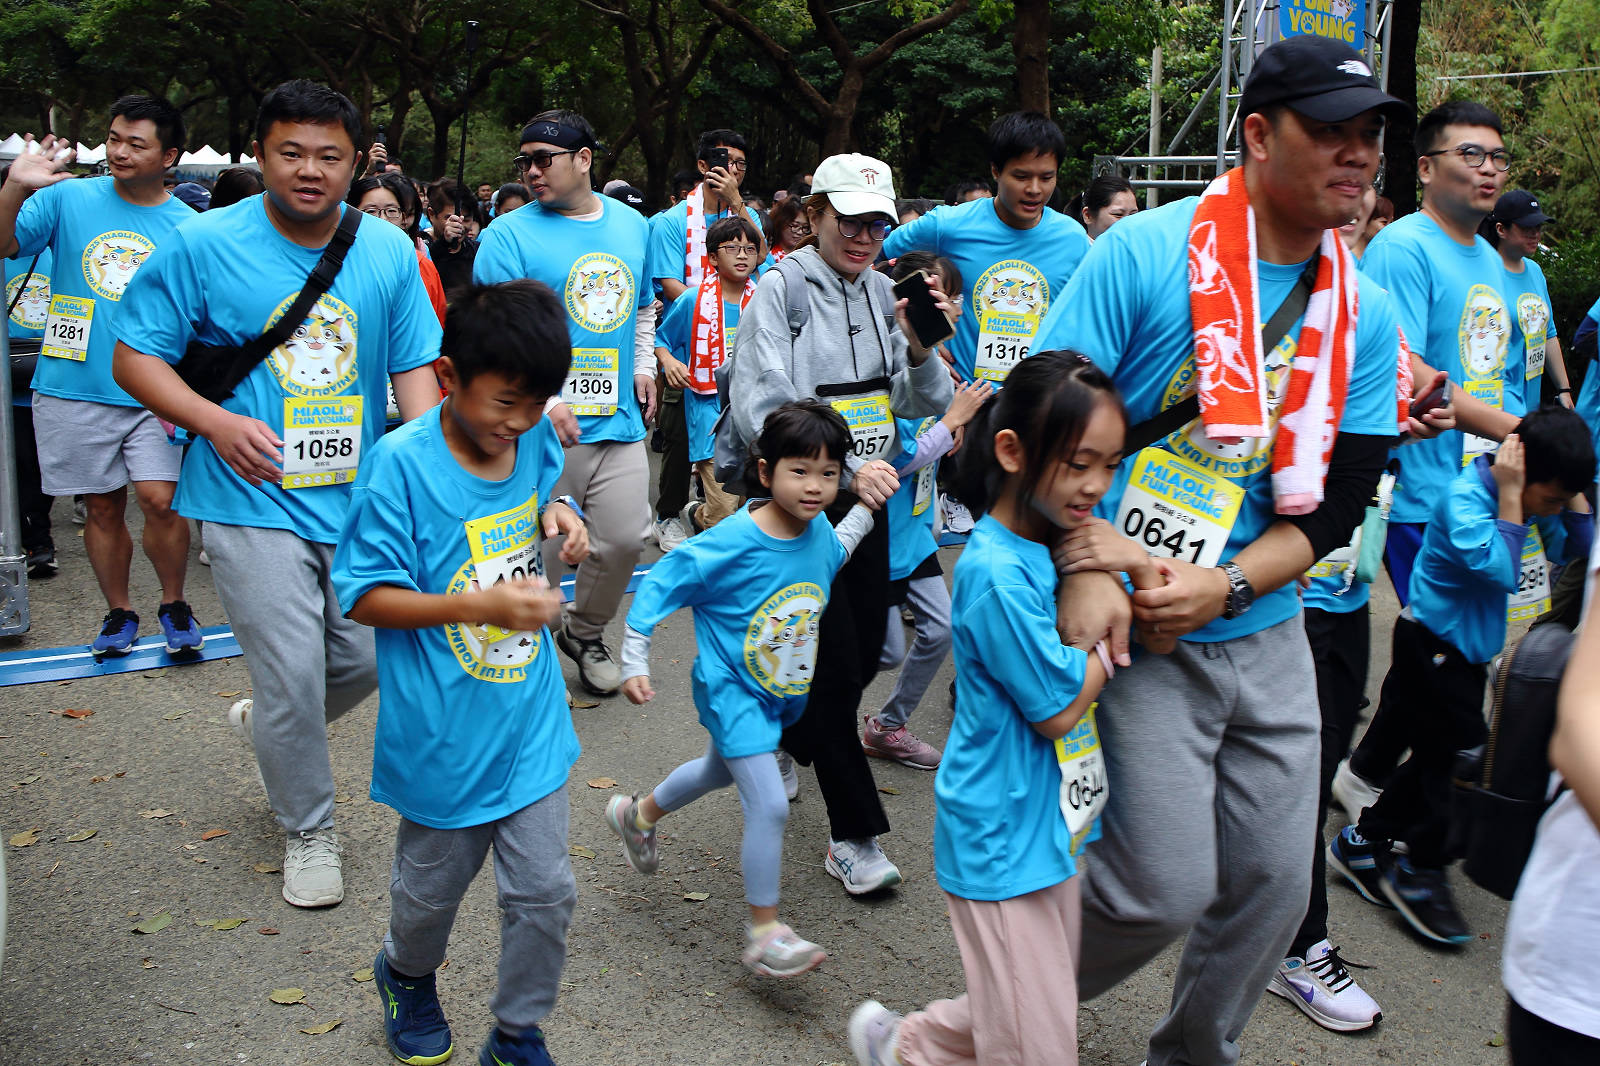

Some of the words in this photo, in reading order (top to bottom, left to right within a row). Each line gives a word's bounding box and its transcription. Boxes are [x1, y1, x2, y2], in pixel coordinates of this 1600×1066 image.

[1289, 8, 1356, 43] YOUNG
[85, 239, 100, 258] 2025
[100, 231, 132, 242] MIAOLI
[974, 276, 990, 297] 2025
[988, 261, 1019, 276] MIAOLI
[1020, 262, 1037, 276] FUN
[54, 300, 82, 311] MIAOLI
[51, 323, 84, 341] 1281
[986, 317, 1025, 328] MIAOLI
[1005, 326, 1032, 335] YOUNG
[984, 343, 1030, 360] 1316
[569, 379, 612, 394] 1309
[293, 406, 343, 417] MIAOLI
[293, 417, 315, 425] FUN
[317, 415, 353, 424] YOUNG
[839, 406, 880, 419] MIAOLI
[847, 417, 858, 425] UN
[294, 437, 353, 460] 1058
[854, 435, 889, 456] 057
[1178, 440, 1210, 468] FUN
[1144, 460, 1216, 502] MIAOLI
[1140, 475, 1169, 496] FUN
[1172, 488, 1224, 519] YOUNG
[480, 511, 534, 546] MIAOLI
[1124, 507, 1206, 564] 0641
[483, 538, 511, 556] FUN
[762, 588, 803, 616] MIAOLI
